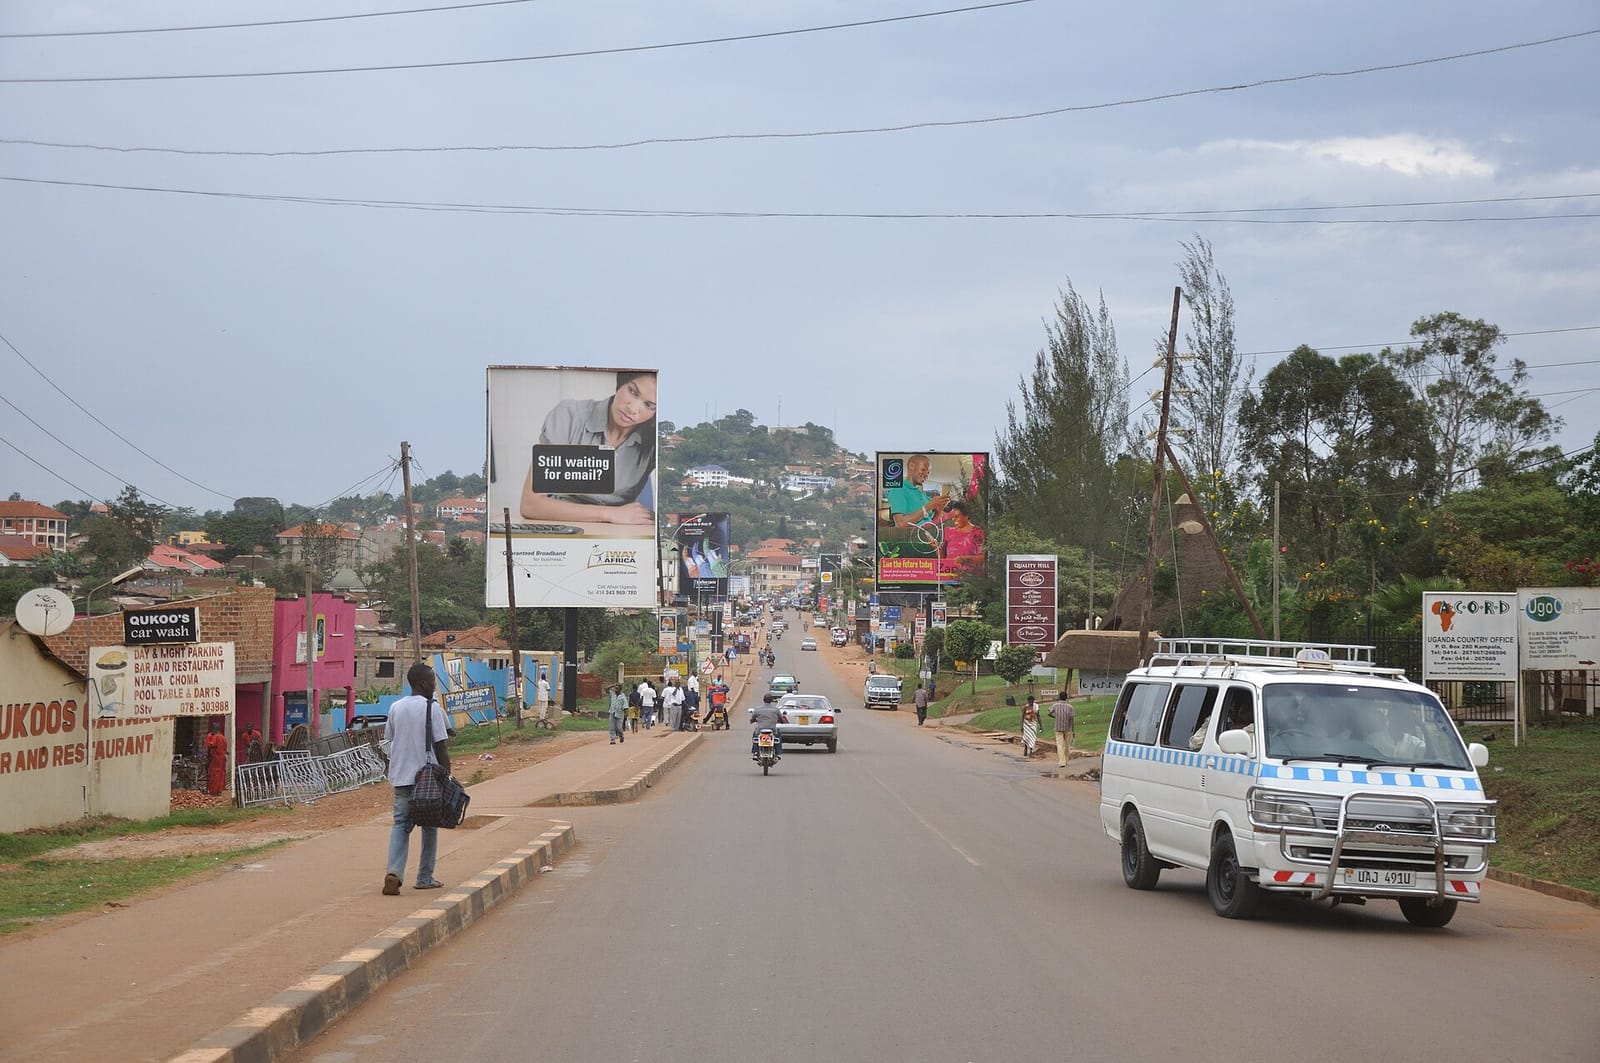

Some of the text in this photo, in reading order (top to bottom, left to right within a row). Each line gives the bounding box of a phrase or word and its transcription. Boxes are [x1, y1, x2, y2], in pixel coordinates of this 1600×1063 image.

[538, 455, 609, 471] Still waiting
[544, 468, 603, 481] for email?
[129, 614, 190, 625] QUKOO'S
[131, 625, 190, 638] car wash
[1490, 636, 1515, 644] OFFICE
[134, 646, 223, 660] DAY & NIGHT PARKING
[134, 660, 225, 674] BAR AND RESTAURANT
[134, 674, 199, 687] NYAMA CHOMA
[134, 689, 156, 701] POOL
[158, 688, 183, 700] TABLE
[194, 687, 220, 698] DARTS
[446, 687, 490, 702] STAY SMART
[134, 704, 153, 715] DStv
[180, 702, 194, 713] 078
[201, 701, 229, 713] 303988
[15, 746, 49, 773] AND
[52, 734, 154, 768] RESAURANT
[1358, 870, 1411, 885] UAJ 491U
